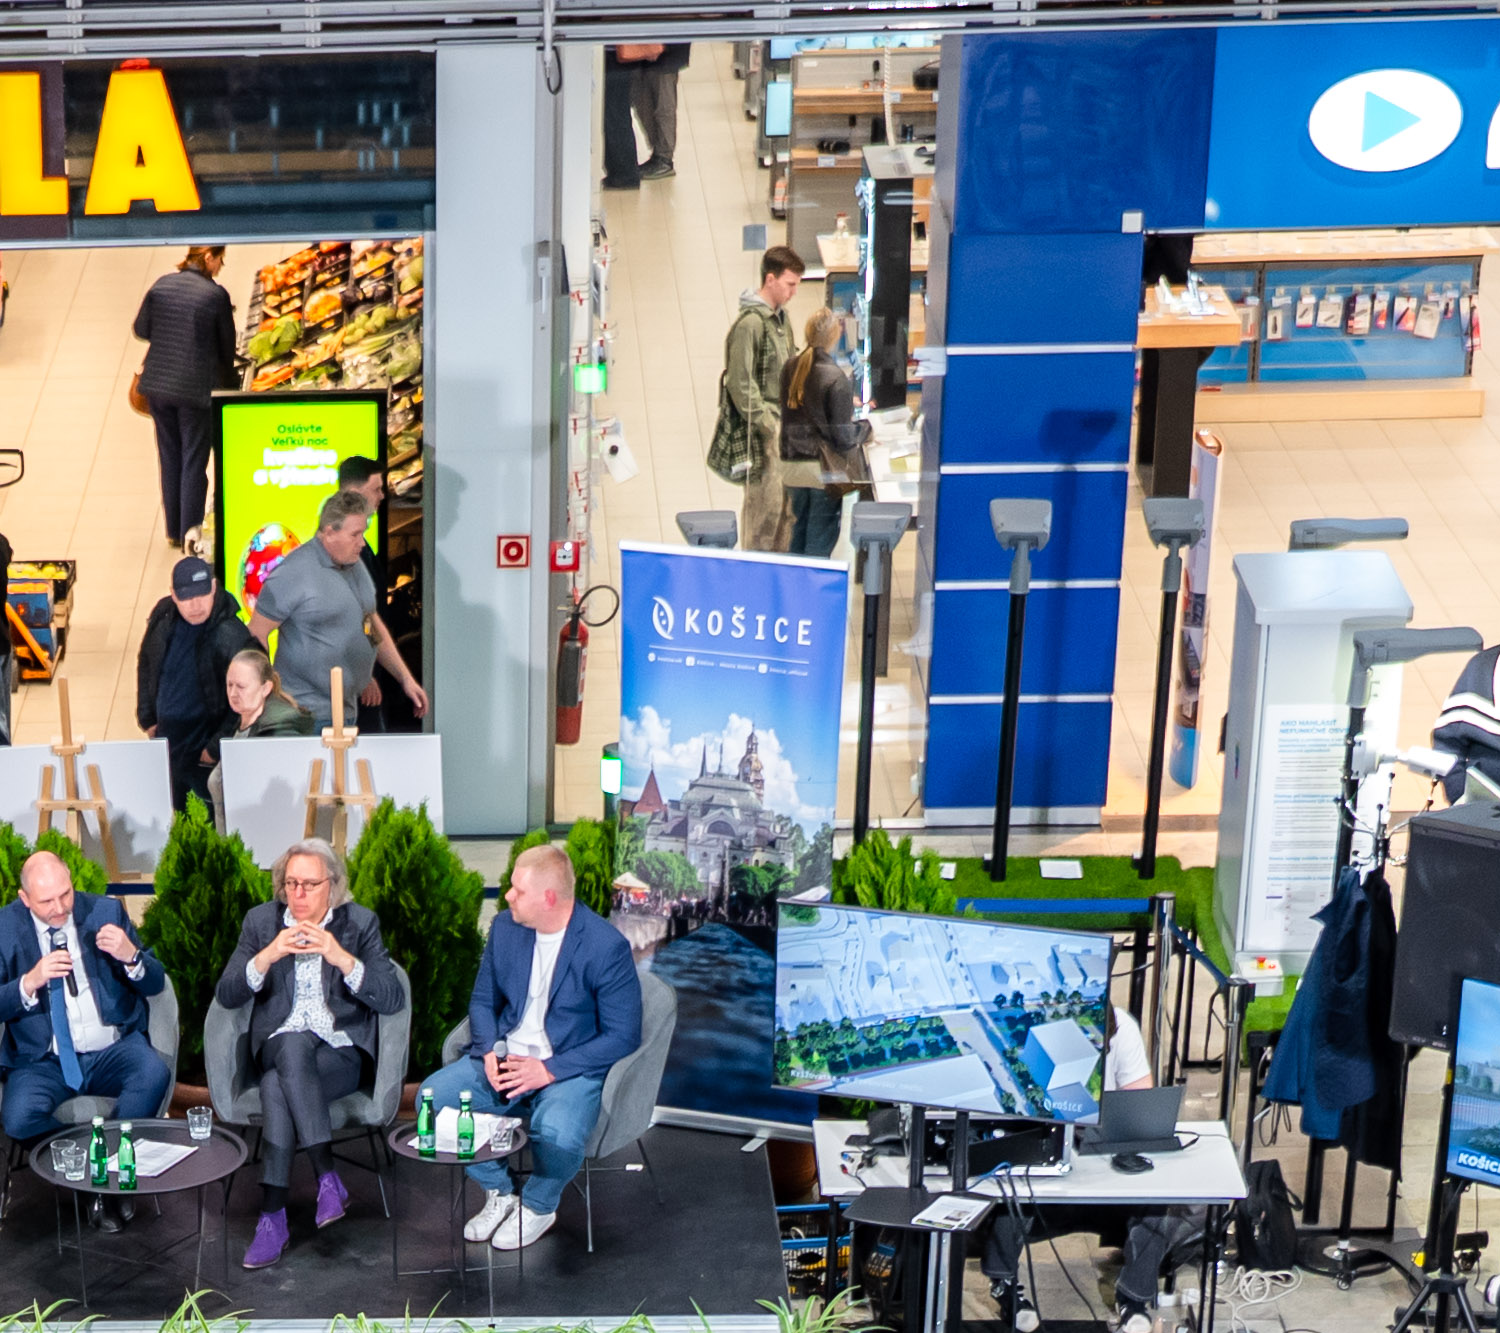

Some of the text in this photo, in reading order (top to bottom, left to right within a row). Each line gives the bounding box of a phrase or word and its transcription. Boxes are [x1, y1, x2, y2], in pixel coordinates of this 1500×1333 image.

[277, 424, 322, 434] Oslávte
[272, 436, 328, 446] Veľkú noc
[685, 605, 812, 646] KOŠICE
